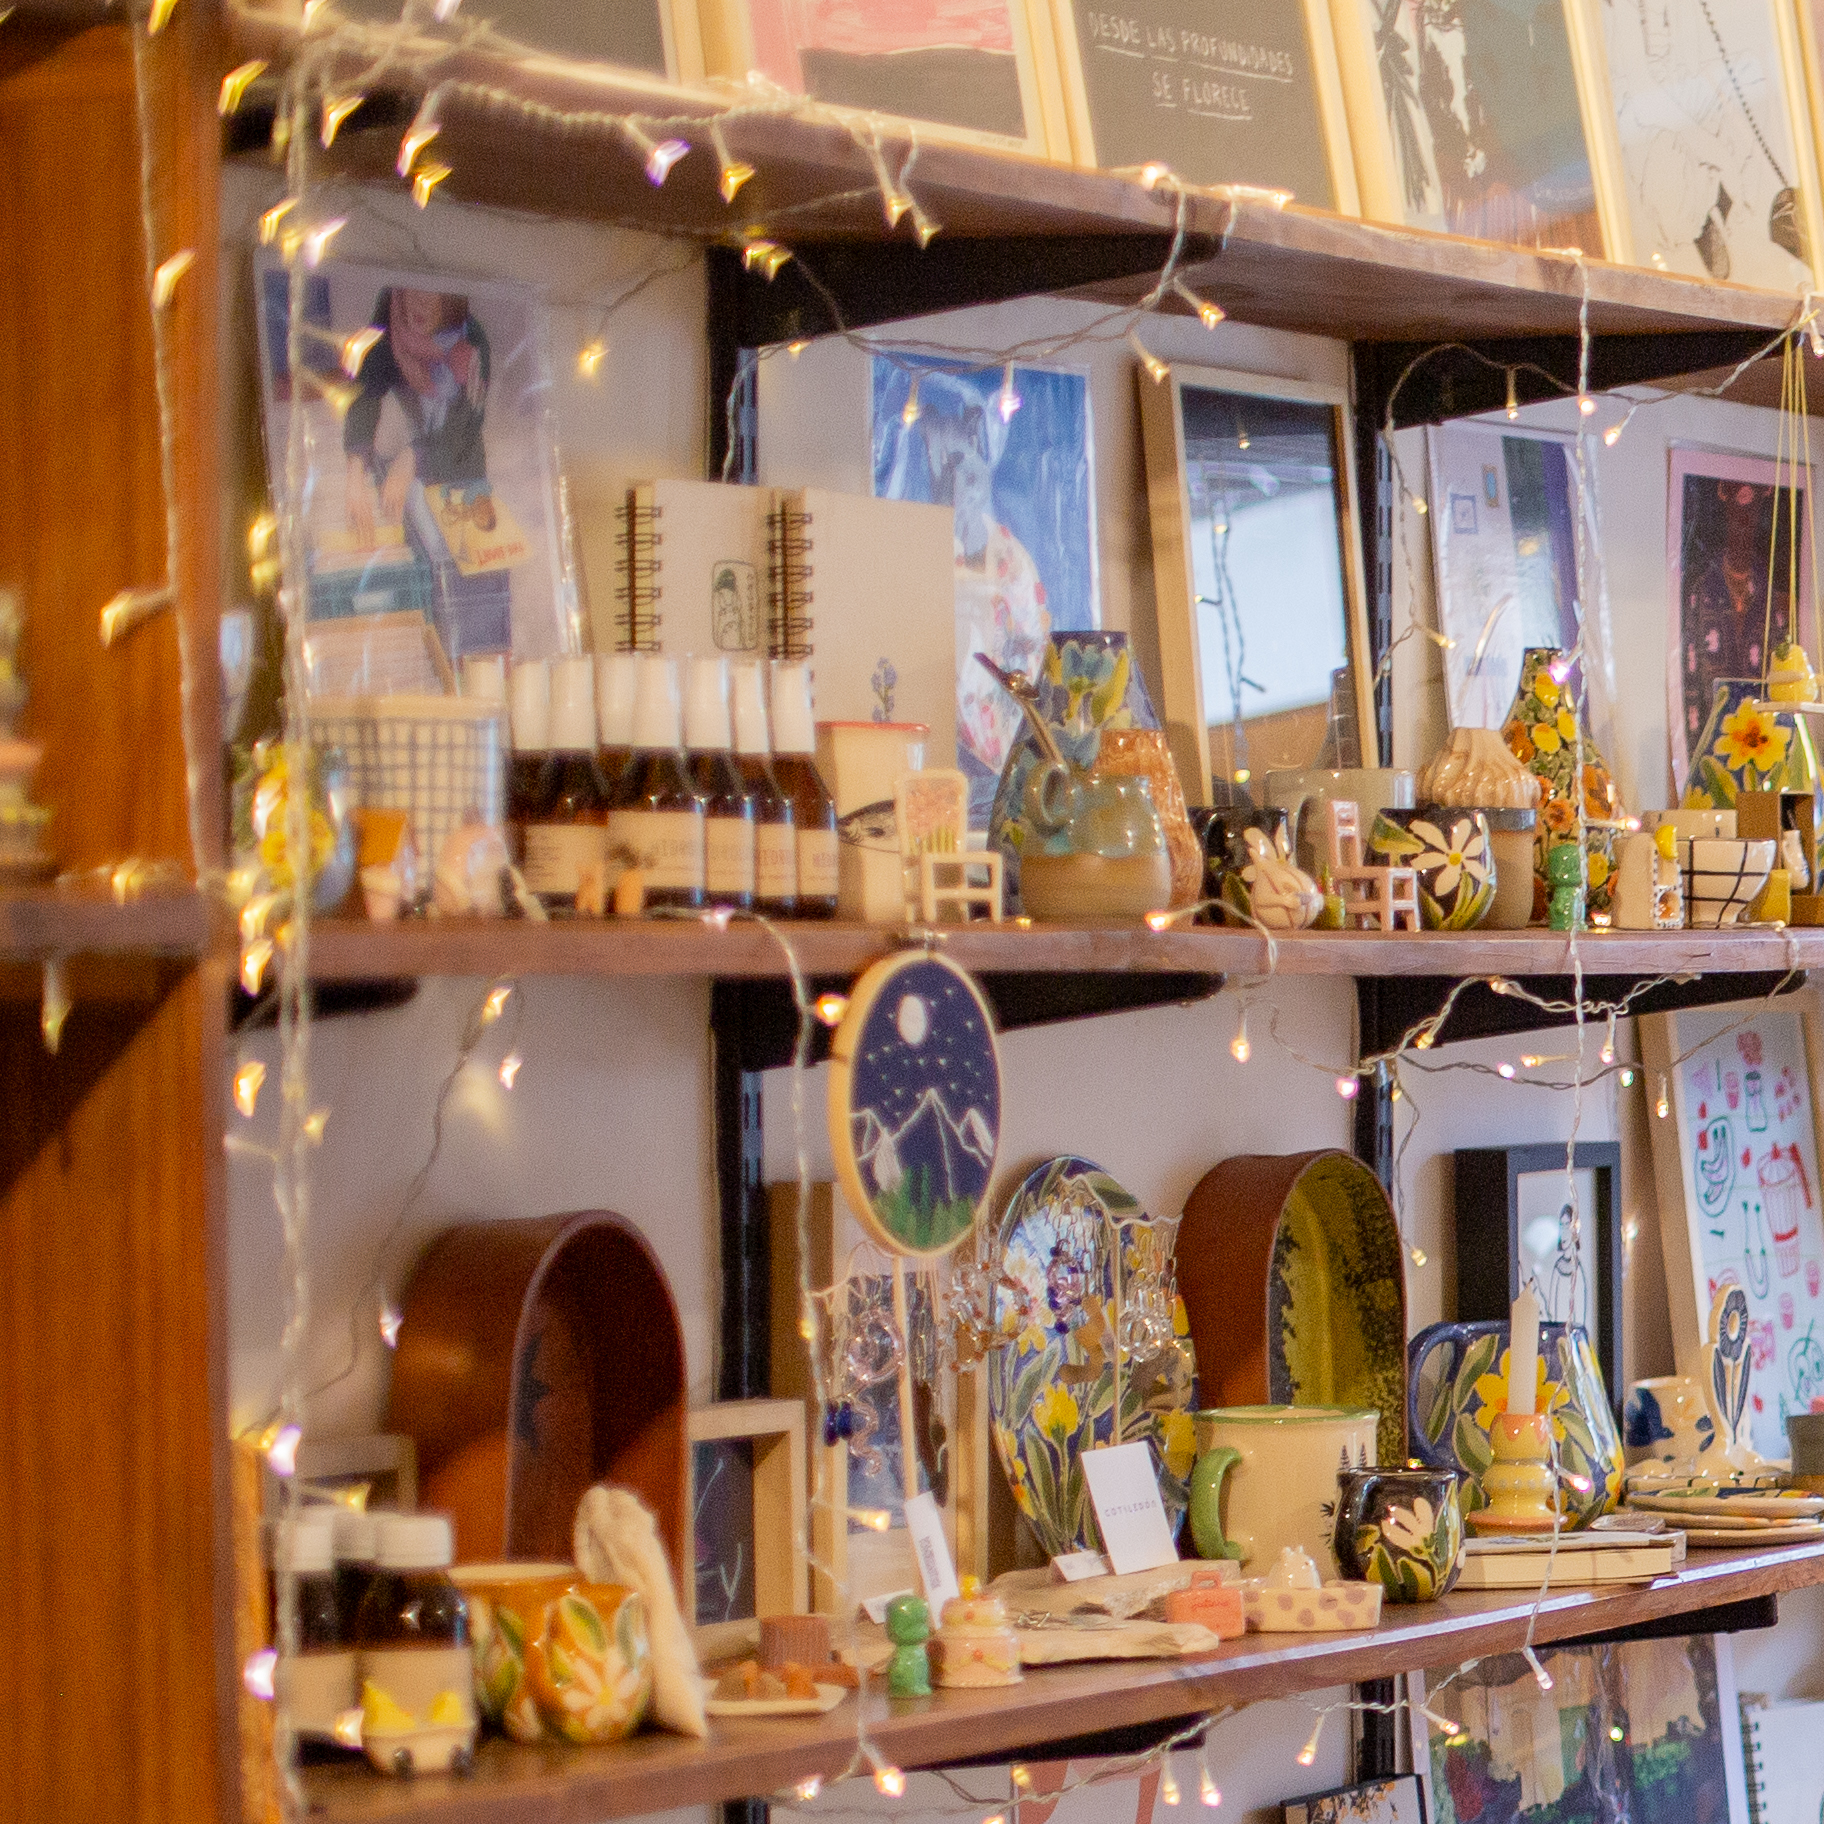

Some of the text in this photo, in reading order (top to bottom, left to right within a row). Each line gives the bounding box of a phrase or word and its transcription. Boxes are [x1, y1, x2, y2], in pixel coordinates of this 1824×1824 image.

[1088, 11, 1141, 44] DESDE
[1146, 26, 1176, 53] LAS
[1152, 71, 1249, 111] SE FLORECE
